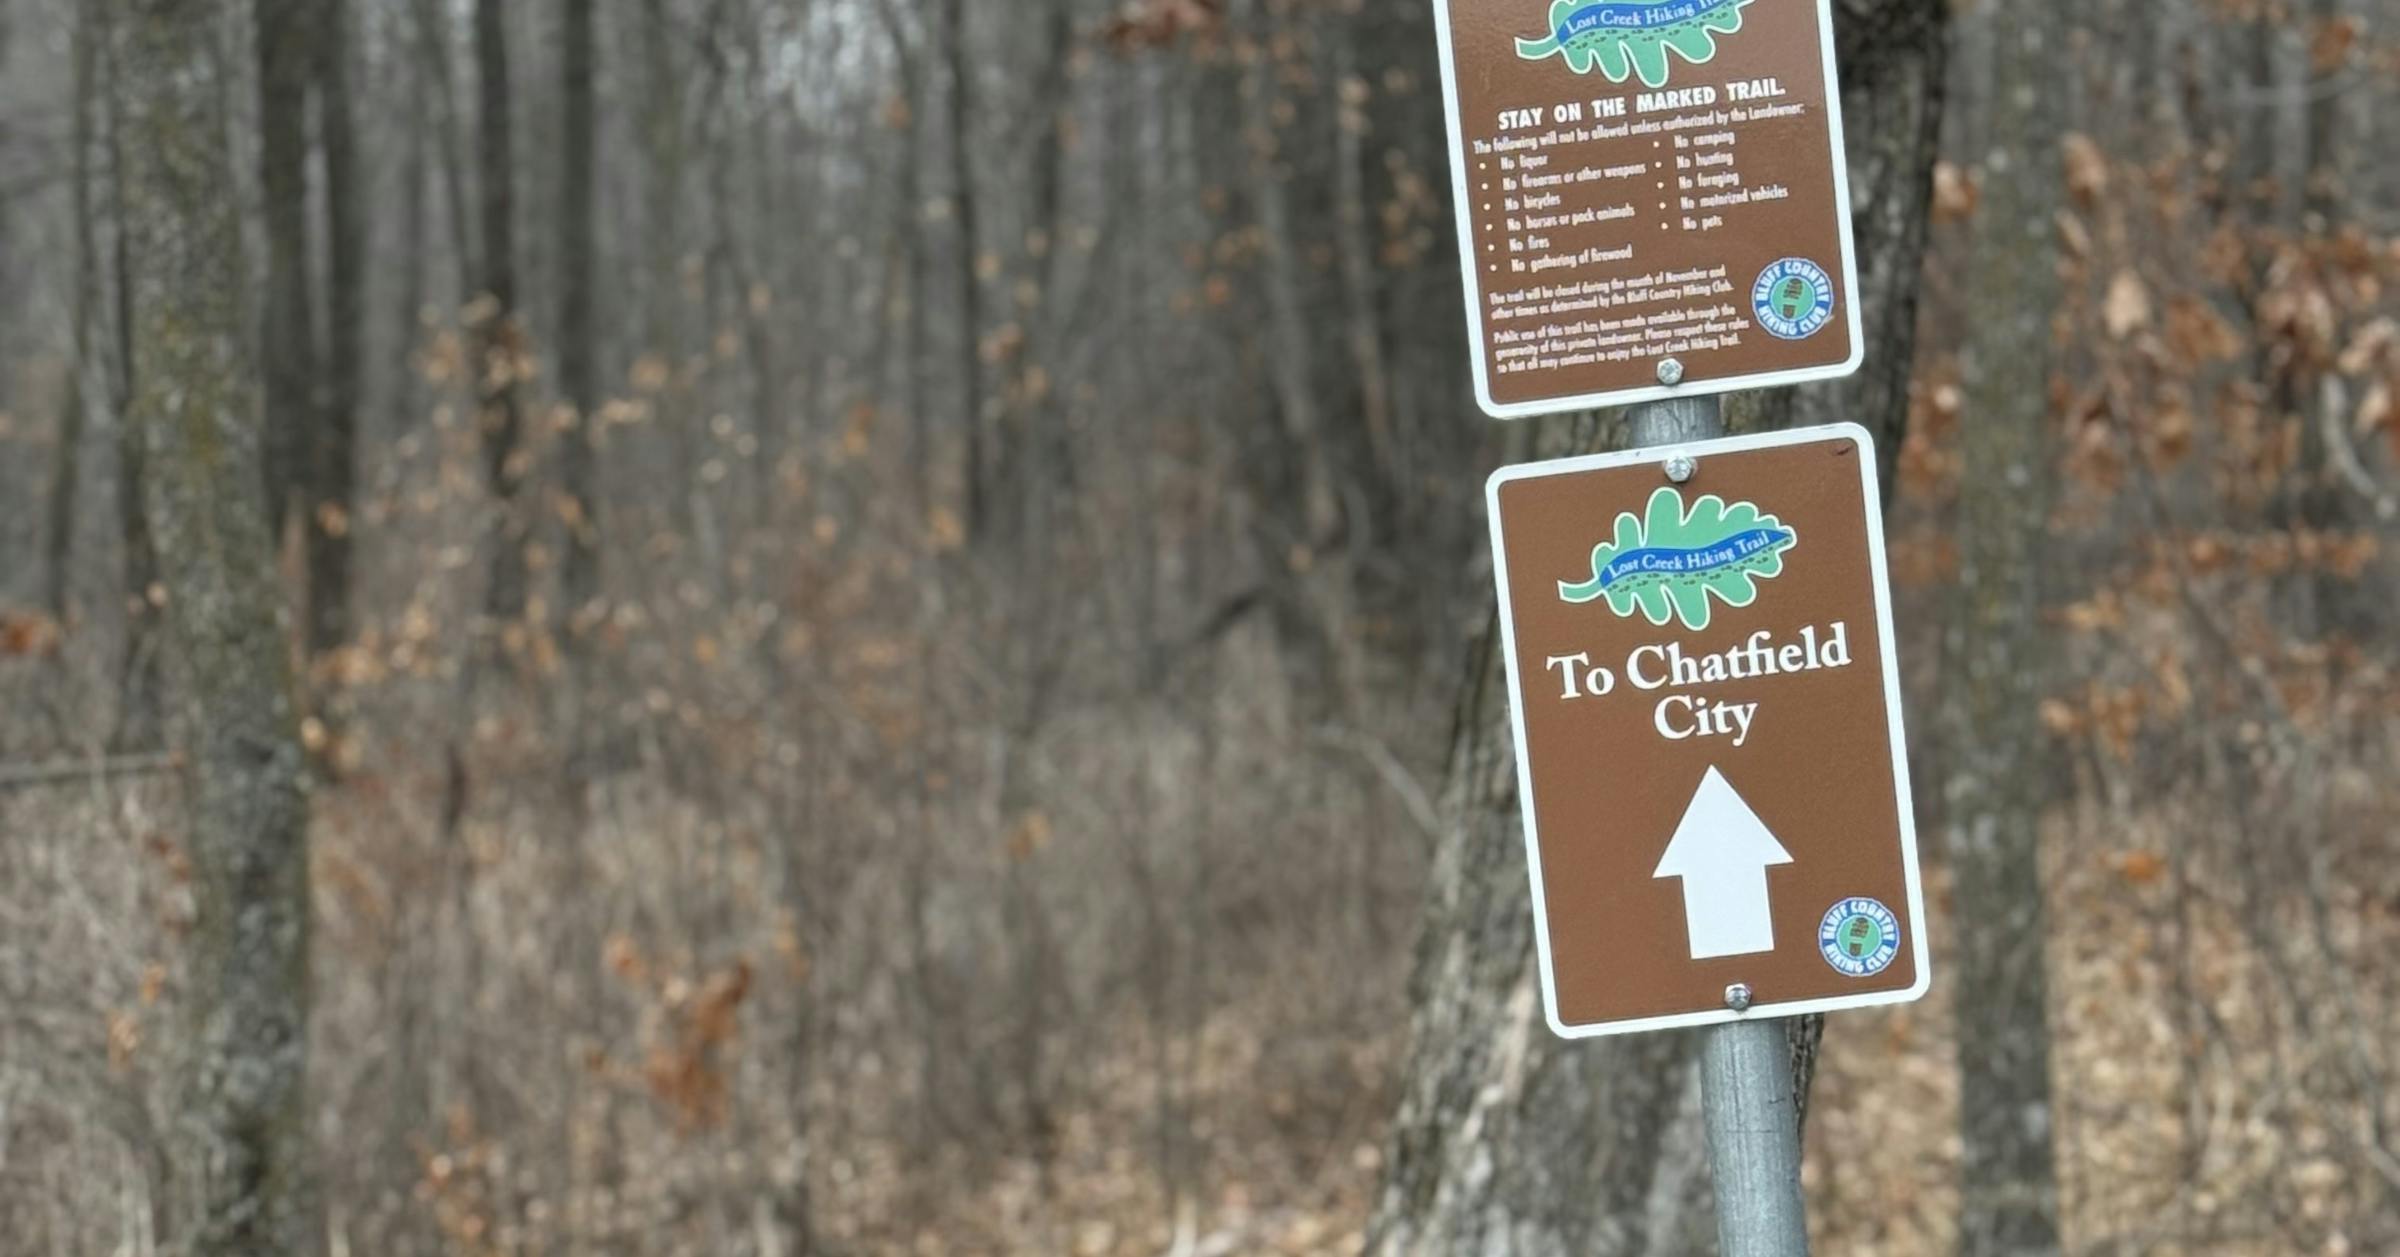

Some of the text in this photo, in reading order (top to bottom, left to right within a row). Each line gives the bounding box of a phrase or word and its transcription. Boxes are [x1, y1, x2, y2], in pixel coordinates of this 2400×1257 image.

[1565, 14, 1598, 34] Lost
[1600, 10, 1642, 26] Creek
[1646, 3, 1696, 25] Hiking
[1497, 77, 1787, 131] STAY ON THE MARKED TRAIL.
[1472, 139, 1492, 154] The
[1492, 135, 1539, 152] following
[1538, 130, 1558, 146] will
[1558, 130, 1576, 144] not
[1575, 127, 1590, 142] be
[1590, 121, 1629, 140] allowed
[1630, 119, 1662, 135] unless
[1661, 110, 1715, 131] authorized
[1715, 109, 1730, 126] by
[1729, 107, 1747, 122] the
[1674, 130, 1736, 149] No camping
[1500, 153, 1548, 171] No liquor
[1676, 151, 1734, 169] No hunting
[1502, 163, 1647, 191] No firearms or other weapons
[1678, 171, 1740, 190] No foraging
[1504, 191, 1561, 212] No bicycles
[1680, 183, 1789, 210] No motorized vehicles
[1506, 202, 1636, 232] No horses or pack animals
[1682, 215, 1723, 231] No pets
[1508, 234, 1550, 252] No fires
[1511, 243, 1633, 273] No gathering of firewood
[1755, 261, 1830, 302] BLUFF COUNTRY
[1758, 305, 1827, 335] HIKING CLUB
[1607, 531, 1769, 579] Lost Creek Hiking Trail
[1546, 621, 1852, 699] To Chatfield
[1654, 694, 1758, 746] City
[1822, 901, 1896, 940] BLUFF COUNTRY
[1824, 943, 1893, 973] HIKING CLUB
